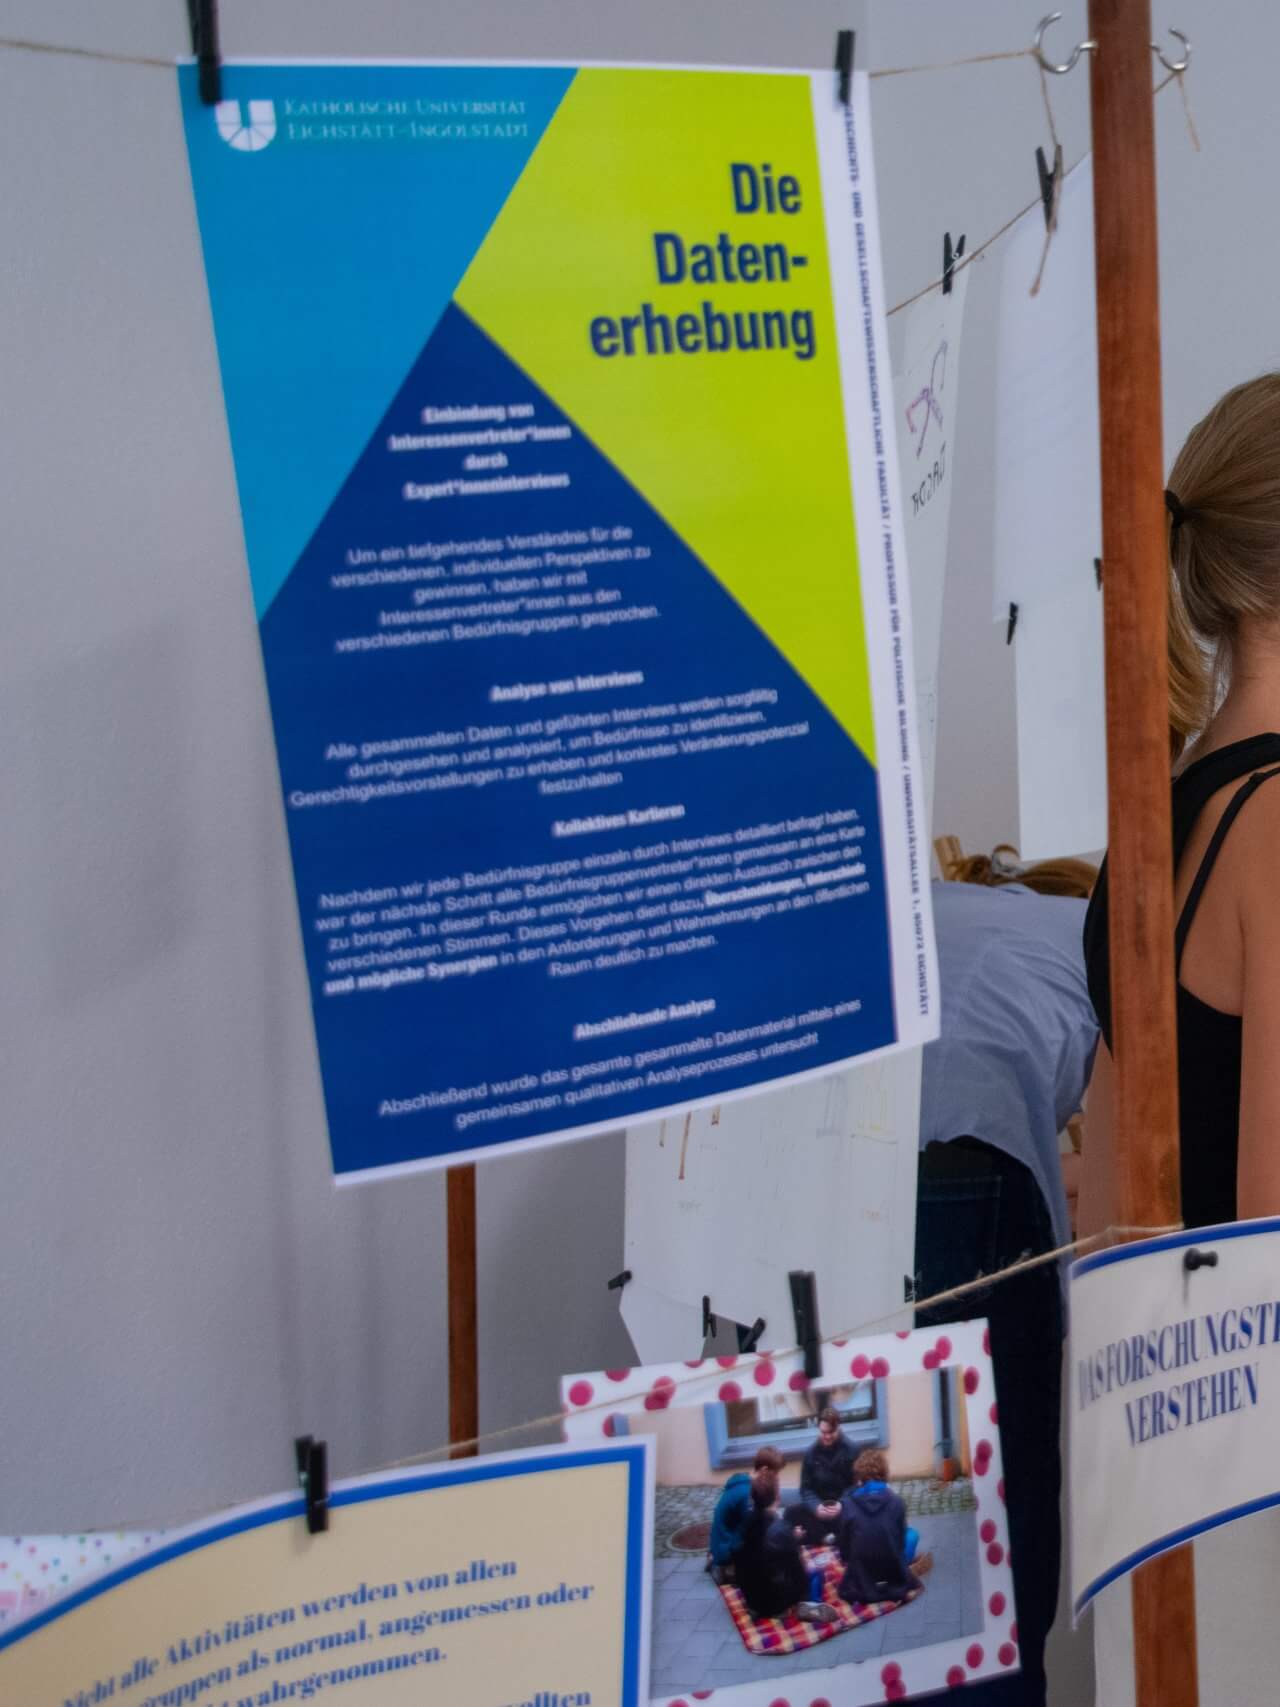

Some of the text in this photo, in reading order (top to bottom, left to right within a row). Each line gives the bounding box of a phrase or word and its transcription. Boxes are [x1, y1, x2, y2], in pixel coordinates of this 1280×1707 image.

[730, 162, 802, 214] Die
[851, 191, 863, 218] UND
[653, 232, 808, 285] Daten-
[588, 301, 817, 361] erhebung
[423, 404, 535, 424] Einbindung von
[464, 453, 508, 470] durch
[347, 526, 633, 564] Um ein tiefgehendes Verständnis für die
[453, 555, 543, 575] individuellen
[545, 547, 633, 569] Perspektiven
[634, 548, 651, 559] zu
[884, 532, 897, 605] PROFESSUR
[494, 575, 540, 594] haben
[542, 574, 563, 588] wir
[566, 571, 588, 585] mit
[567, 594, 594, 607] aus
[595, 589, 622, 603] den
[335, 630, 450, 653] verschiedenen
[453, 615, 579, 640] Bedürfnisgruppen
[890, 608, 900, 633] FÜR
[491, 672, 644, 702] Analyse von Interviews
[893, 636, 905, 705] POLITISCHE
[325, 745, 357, 759] Alle
[361, 731, 465, 759] gesammelten
[467, 725, 513, 743] Daten
[515, 720, 543, 735] und
[545, 712, 611, 735] geführten
[612, 704, 678, 723] Interviews
[679, 695, 724, 712] werden
[348, 753, 459, 779] durchgesehen
[462, 746, 491, 762] und
[568, 734, 592, 749] um
[593, 723, 670, 746] Bedürfnisse
[671, 722, 689, 735] zu
[898, 708, 909, 761] BILDUNG
[290, 767, 504, 807] Gerechtigkeitsvorstellungen
[506, 766, 525, 779] zu
[527, 756, 586, 776] erheben
[587, 751, 614, 767] und
[615, 743, 679, 763] konkretes
[540, 771, 623, 795] festzuhalten
[553, 804, 685, 838] Kollektives Kartieren
[316, 918, 347, 932] war
[351, 912, 376, 926] der
[381, 903, 441, 922] nächste
[445, 892, 493, 913] Schritt
[496, 887, 523, 903] alle
[733, 840, 799, 864] gemeinsam
[799, 837, 815, 848] an
[815, 832, 838, 845] eine
[838, 824, 866, 842] Karte
[320, 887, 399, 910] Nachdem
[401, 883, 425, 897] wir
[427, 878, 461, 896] jede
[463, 858, 582, 889] Bedürfnisgruppe
[583, 851, 632, 869] einzeln
[633, 843, 669, 860] durch
[670, 833, 734, 853] Interviews
[735, 822, 786, 843] detailliert
[329, 937, 350, 951] zu
[420, 922, 437, 936] In
[439, 915, 485, 934] dieser
[488, 906, 537, 924] Runde
[540, 890, 623, 919] ermöglichen
[624, 886, 645, 899] wir
[646, 882, 682, 898] einen
[683, 871, 733, 891] direkten
[733, 859, 793, 883] Austausch
[842, 844, 862, 859] den
[323, 976, 355, 995] und
[358, 965, 425, 991] mögliche
[500, 950, 515, 962] in
[517, 946, 545, 962] den
[548, 929, 646, 956] Anforderungen
[648, 921, 673, 938] und
[776, 899, 792, 912] an
[793, 892, 814, 907] den
[327, 944, 442, 972] verschiedenen
[518, 922, 568, 942] Dieses
[569, 908, 634, 934] Vorgehen
[636, 904, 669, 921] dient
[549, 957, 593, 976] Raum
[594, 948, 646, 969] deutlich
[647, 945, 665, 958] zu
[668, 999, 716, 1021] Analyse
[378, 1083, 489, 1116] Abschließend
[490, 1074, 538, 1096] wurde
[540, 1069, 569, 1084] das
[571, 1056, 633, 1082] gesamte
[634, 1037, 714, 1068] gesammelte
[714, 1016, 797, 1048] Datenmaterial
[456, 1032, 819, 1130] gemeinsamen qualitativen Analyseprozesses untersucht
[1124, 1364, 1259, 1448] VERSTEHEN
[120, 1559, 517, 1690] alle Aktivitäten werden von allen
[236, 1649, 271, 1677] als
[378, 1590, 532, 1637] angemessen
[536, 1582, 595, 1608] oder
